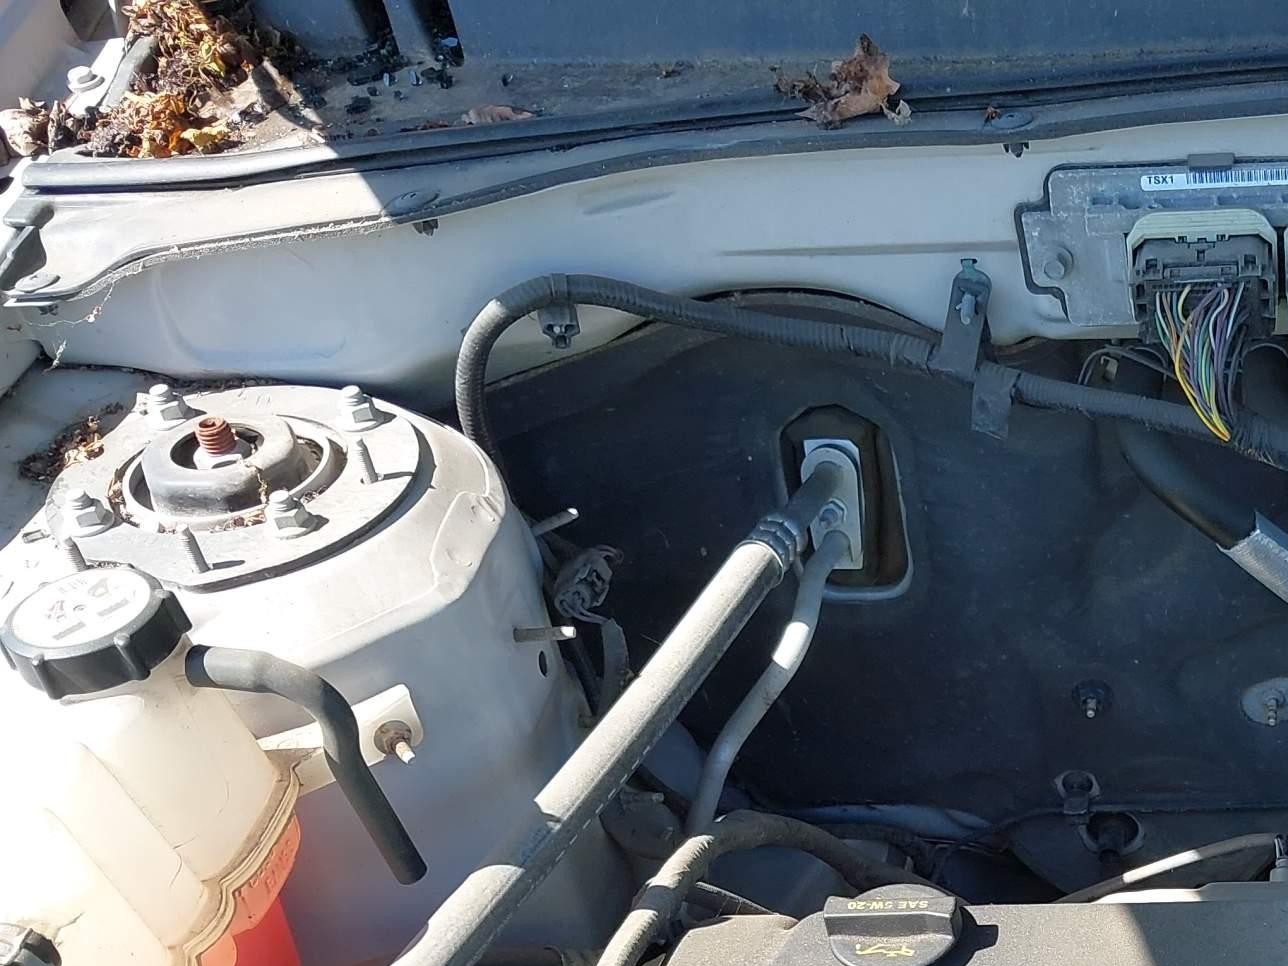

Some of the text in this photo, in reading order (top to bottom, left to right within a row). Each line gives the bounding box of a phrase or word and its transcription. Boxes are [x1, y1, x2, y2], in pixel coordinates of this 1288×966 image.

[1147, 175, 1174, 185] TSX1
[847, 900, 929, 910] SAE 5W-20
